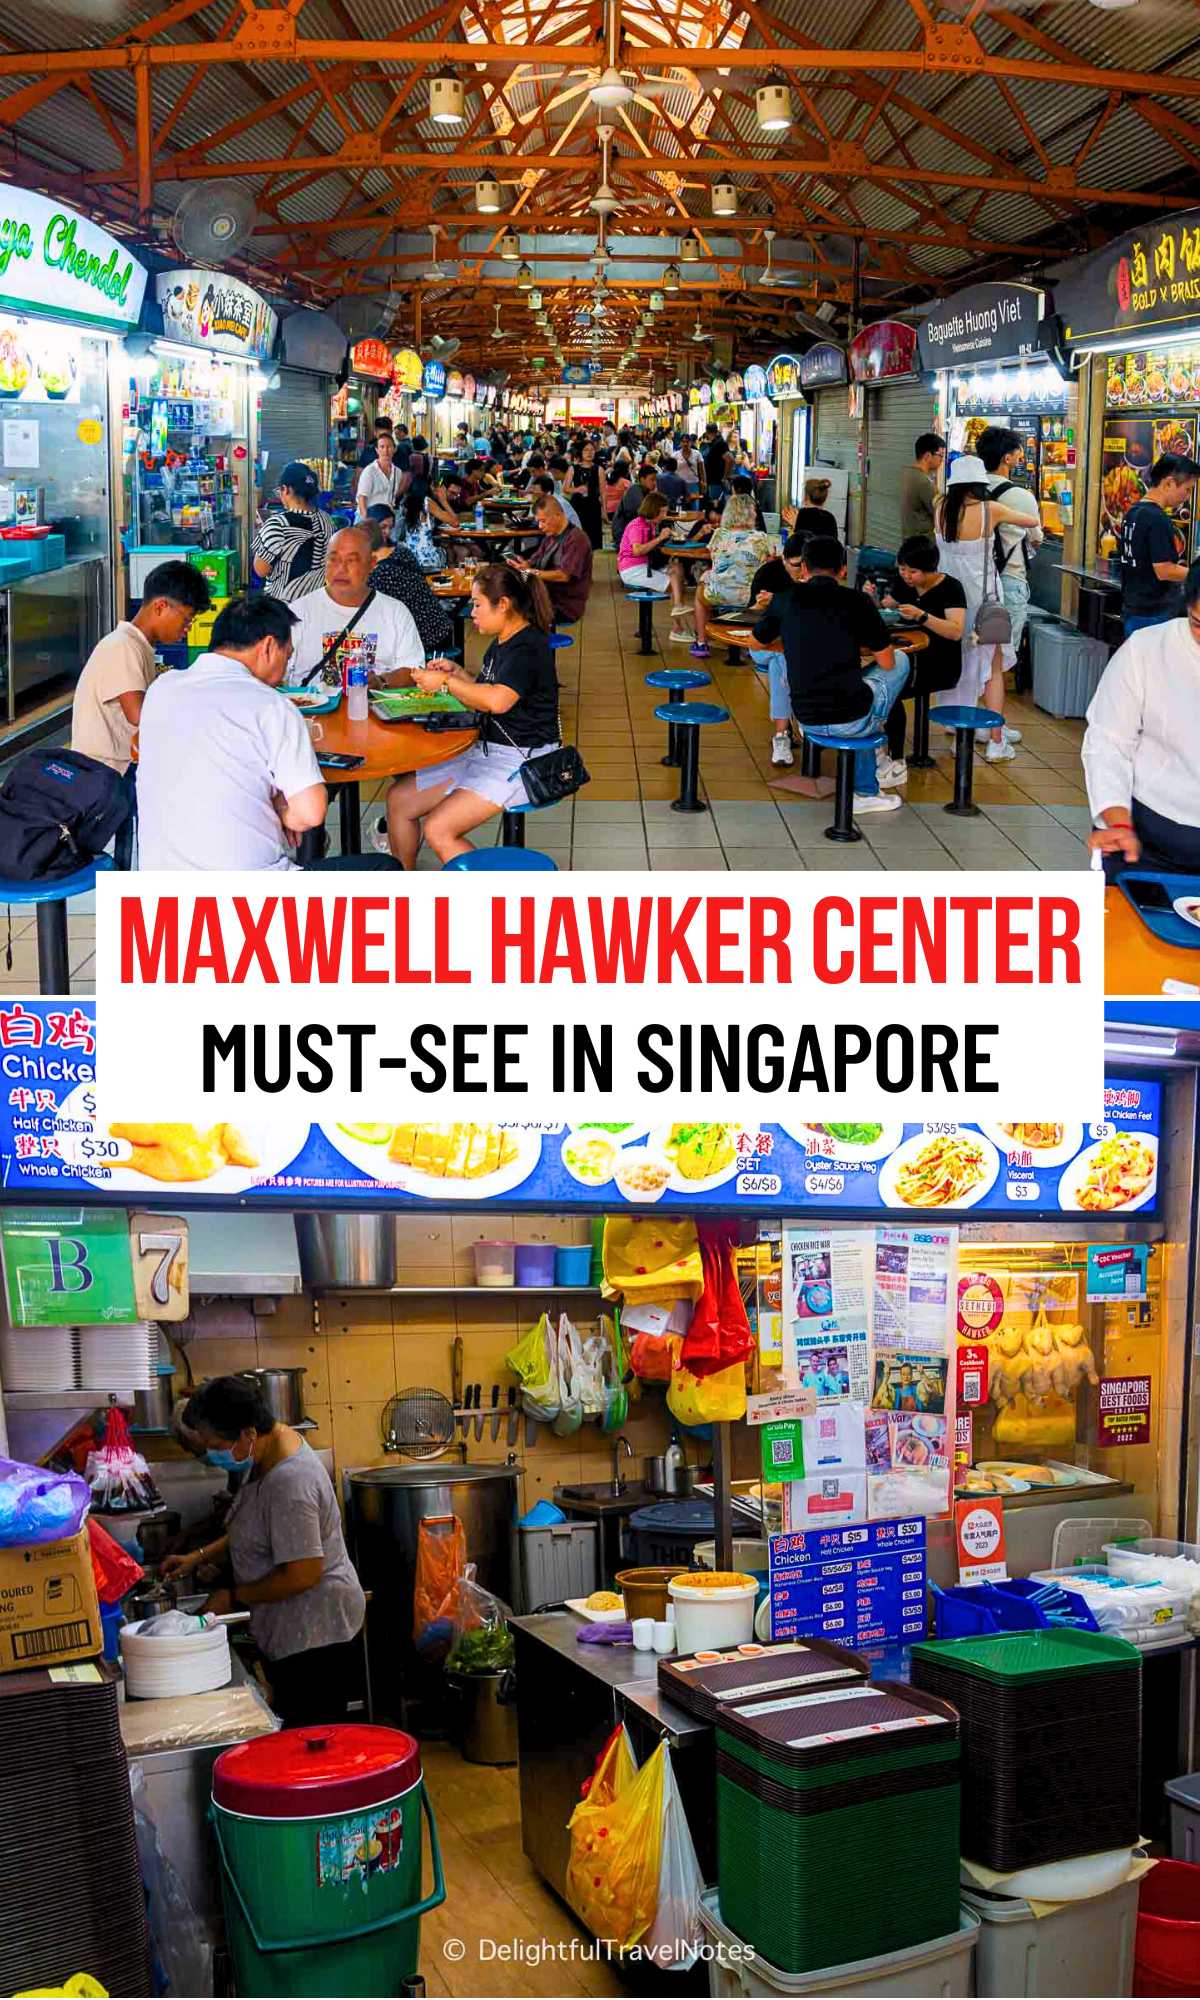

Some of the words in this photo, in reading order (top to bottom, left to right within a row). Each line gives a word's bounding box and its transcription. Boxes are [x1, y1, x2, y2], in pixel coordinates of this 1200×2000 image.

[44, 214, 133, 307] Chendol
[1132, 289, 1157, 311] BOLD
[928, 317, 965, 345] Baguette
[965, 308, 998, 333] Huong
[997, 297, 1021, 325] Viet
[0, 1003, 97, 1055] 白鸡
[2, 1054, 96, 1083] Chicke
[9, 1087, 59, 1113] 半只
[1111, 1110, 1137, 1120] Chicken
[1138, 1111, 1152, 1120] Feet
[13, 1116, 40, 1132] Half
[42, 1119, 94, 1132] Chicken
[1096, 1125, 1109, 1136] $5
[81, 1137, 119, 1159] $30
[736, 1132, 773, 1154] 套餐
[806, 1138, 836, 1155] 油菜
[19, 1163, 59, 1177] Whole
[61, 1163, 112, 1178] Chicken
[736, 1157, 761, 1171] SET
[805, 1160, 832, 1173] Oyster
[834, 1161, 860, 1172] Sauce
[861, 1161, 877, 1174] Veg
[742, 1176, 778, 1193] $6/$8
[809, 1176, 843, 1191] $4/$6
[1014, 1184, 1029, 1199] $3
[790, 1242, 810, 1252] CHICKEN
[44, 1238, 95, 1293] B
[139, 1232, 182, 1304] 7
[961, 1324, 991, 1339] HAWKER
[1101, 1380, 1149, 1396] SINGAPORE
[1101, 1395, 1121, 1408] BEST
[1122, 1393, 1148, 1405] FOODS
[1116, 1433, 1134, 1442] 2022
[901, 1523, 918, 1535] $30
[773, 1534, 806, 1554] 白鸡
[847, 1532, 863, 1542] $15
[832, 1545, 854, 1554] Chicken
[774, 1553, 812, 1566] Chicken
